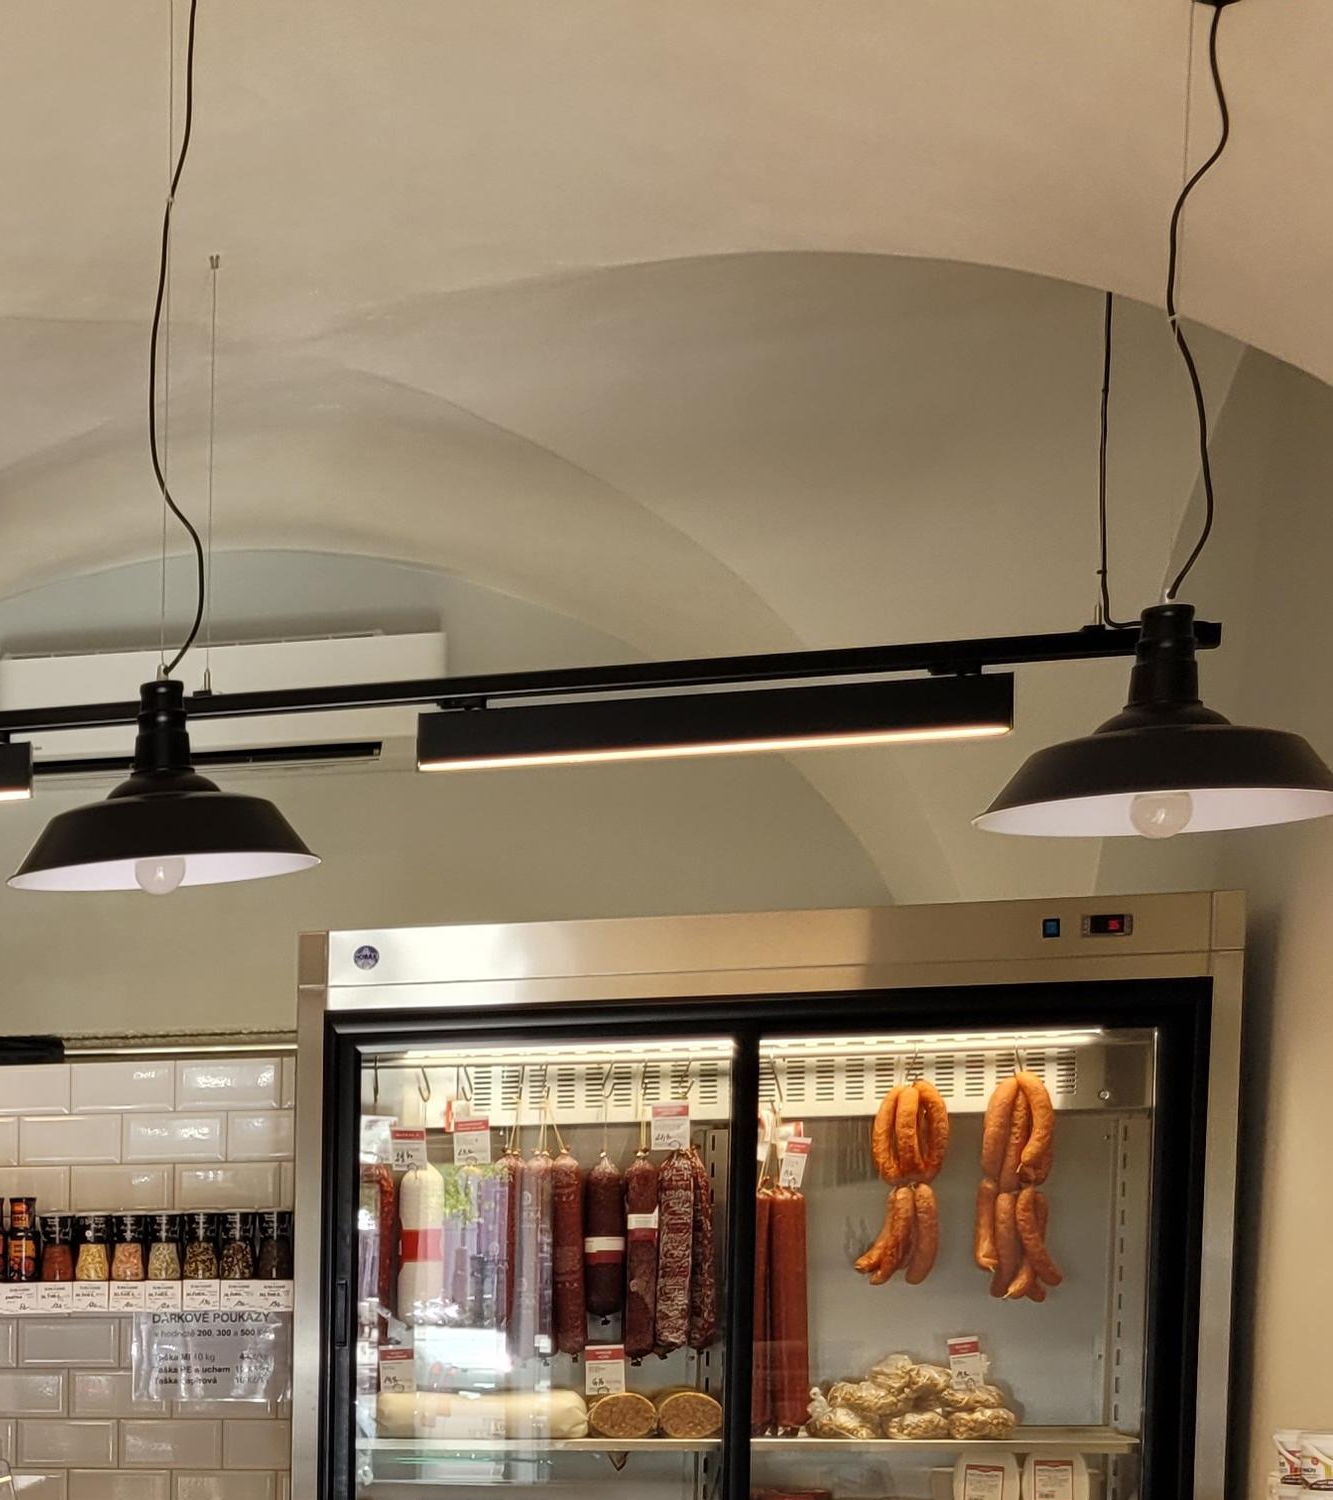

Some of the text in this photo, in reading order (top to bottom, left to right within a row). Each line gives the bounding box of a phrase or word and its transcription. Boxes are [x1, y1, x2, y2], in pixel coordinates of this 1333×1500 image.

[152, 1311, 270, 1324] DÁRKOVÉ POUKAZY
[216, 1329, 232, 1337] 300
[241, 1329, 256, 1337] 500
